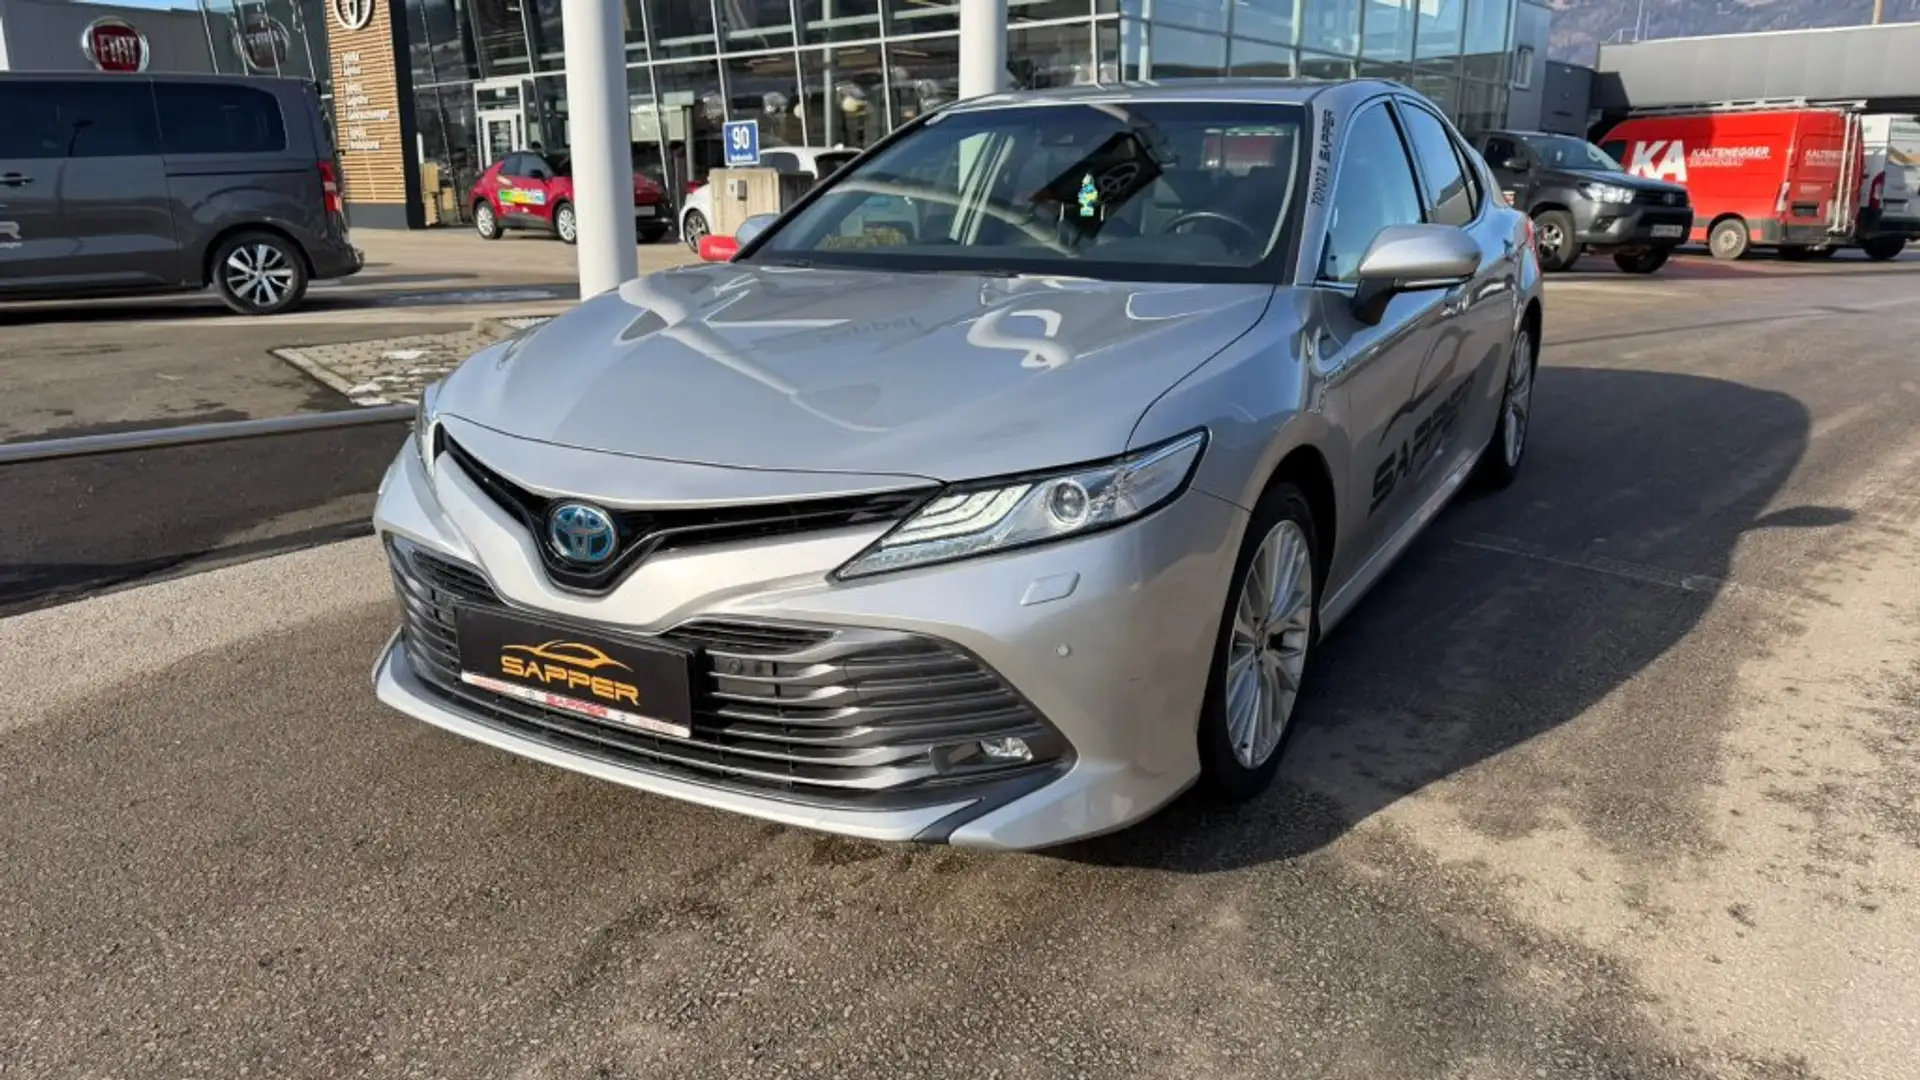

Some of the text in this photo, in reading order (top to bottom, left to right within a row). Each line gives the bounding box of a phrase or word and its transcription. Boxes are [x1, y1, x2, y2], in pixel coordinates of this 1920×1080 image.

[97, 33, 138, 65] FIAT
[732, 126, 749, 149] 90
[1691, 146, 1770, 158] KALTENEGGER
[1310, 108, 1335, 206] TOYOTA SAPPER
[1628, 139, 1688, 182] KA
[501, 655, 640, 706] SAPPER
